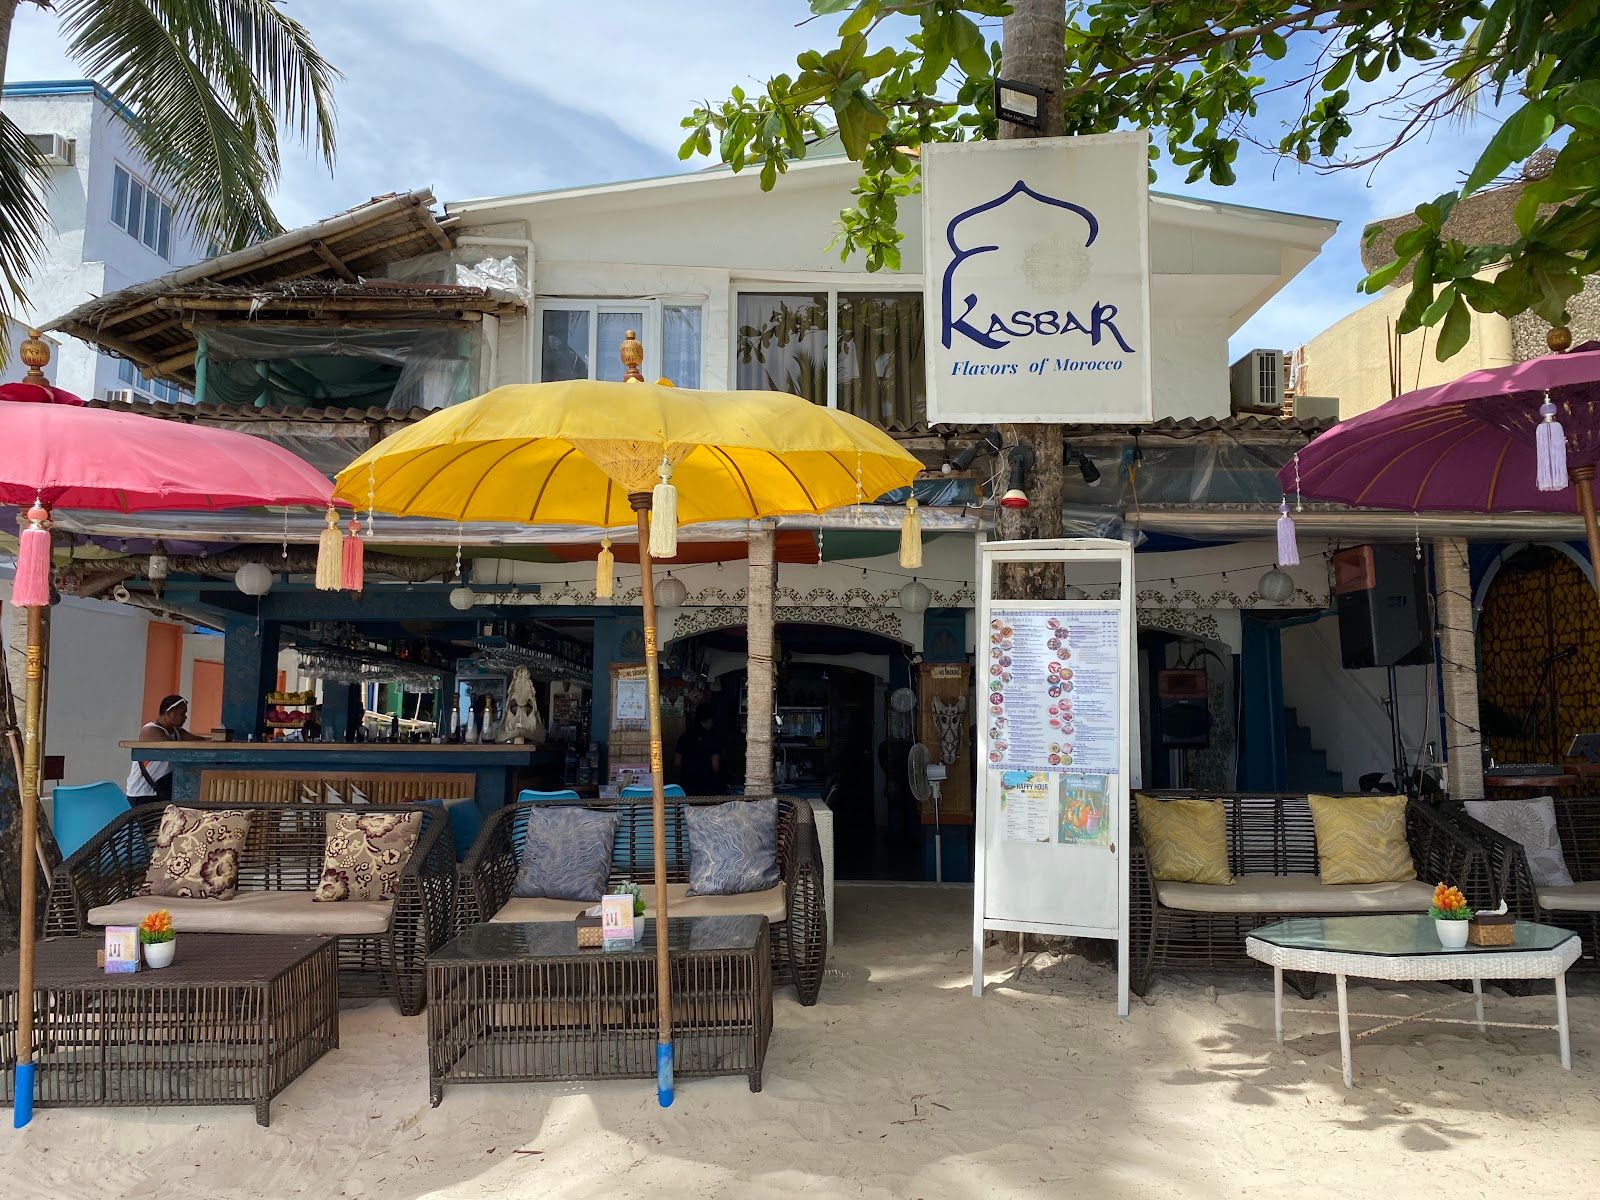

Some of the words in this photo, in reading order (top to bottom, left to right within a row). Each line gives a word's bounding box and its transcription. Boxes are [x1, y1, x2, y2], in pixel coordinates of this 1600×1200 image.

[941, 293, 1136, 353] KASBAR
[951, 361, 1018, 376] Flavors
[1029, 358, 1050, 376] of
[1053, 357, 1123, 372] Morocco
